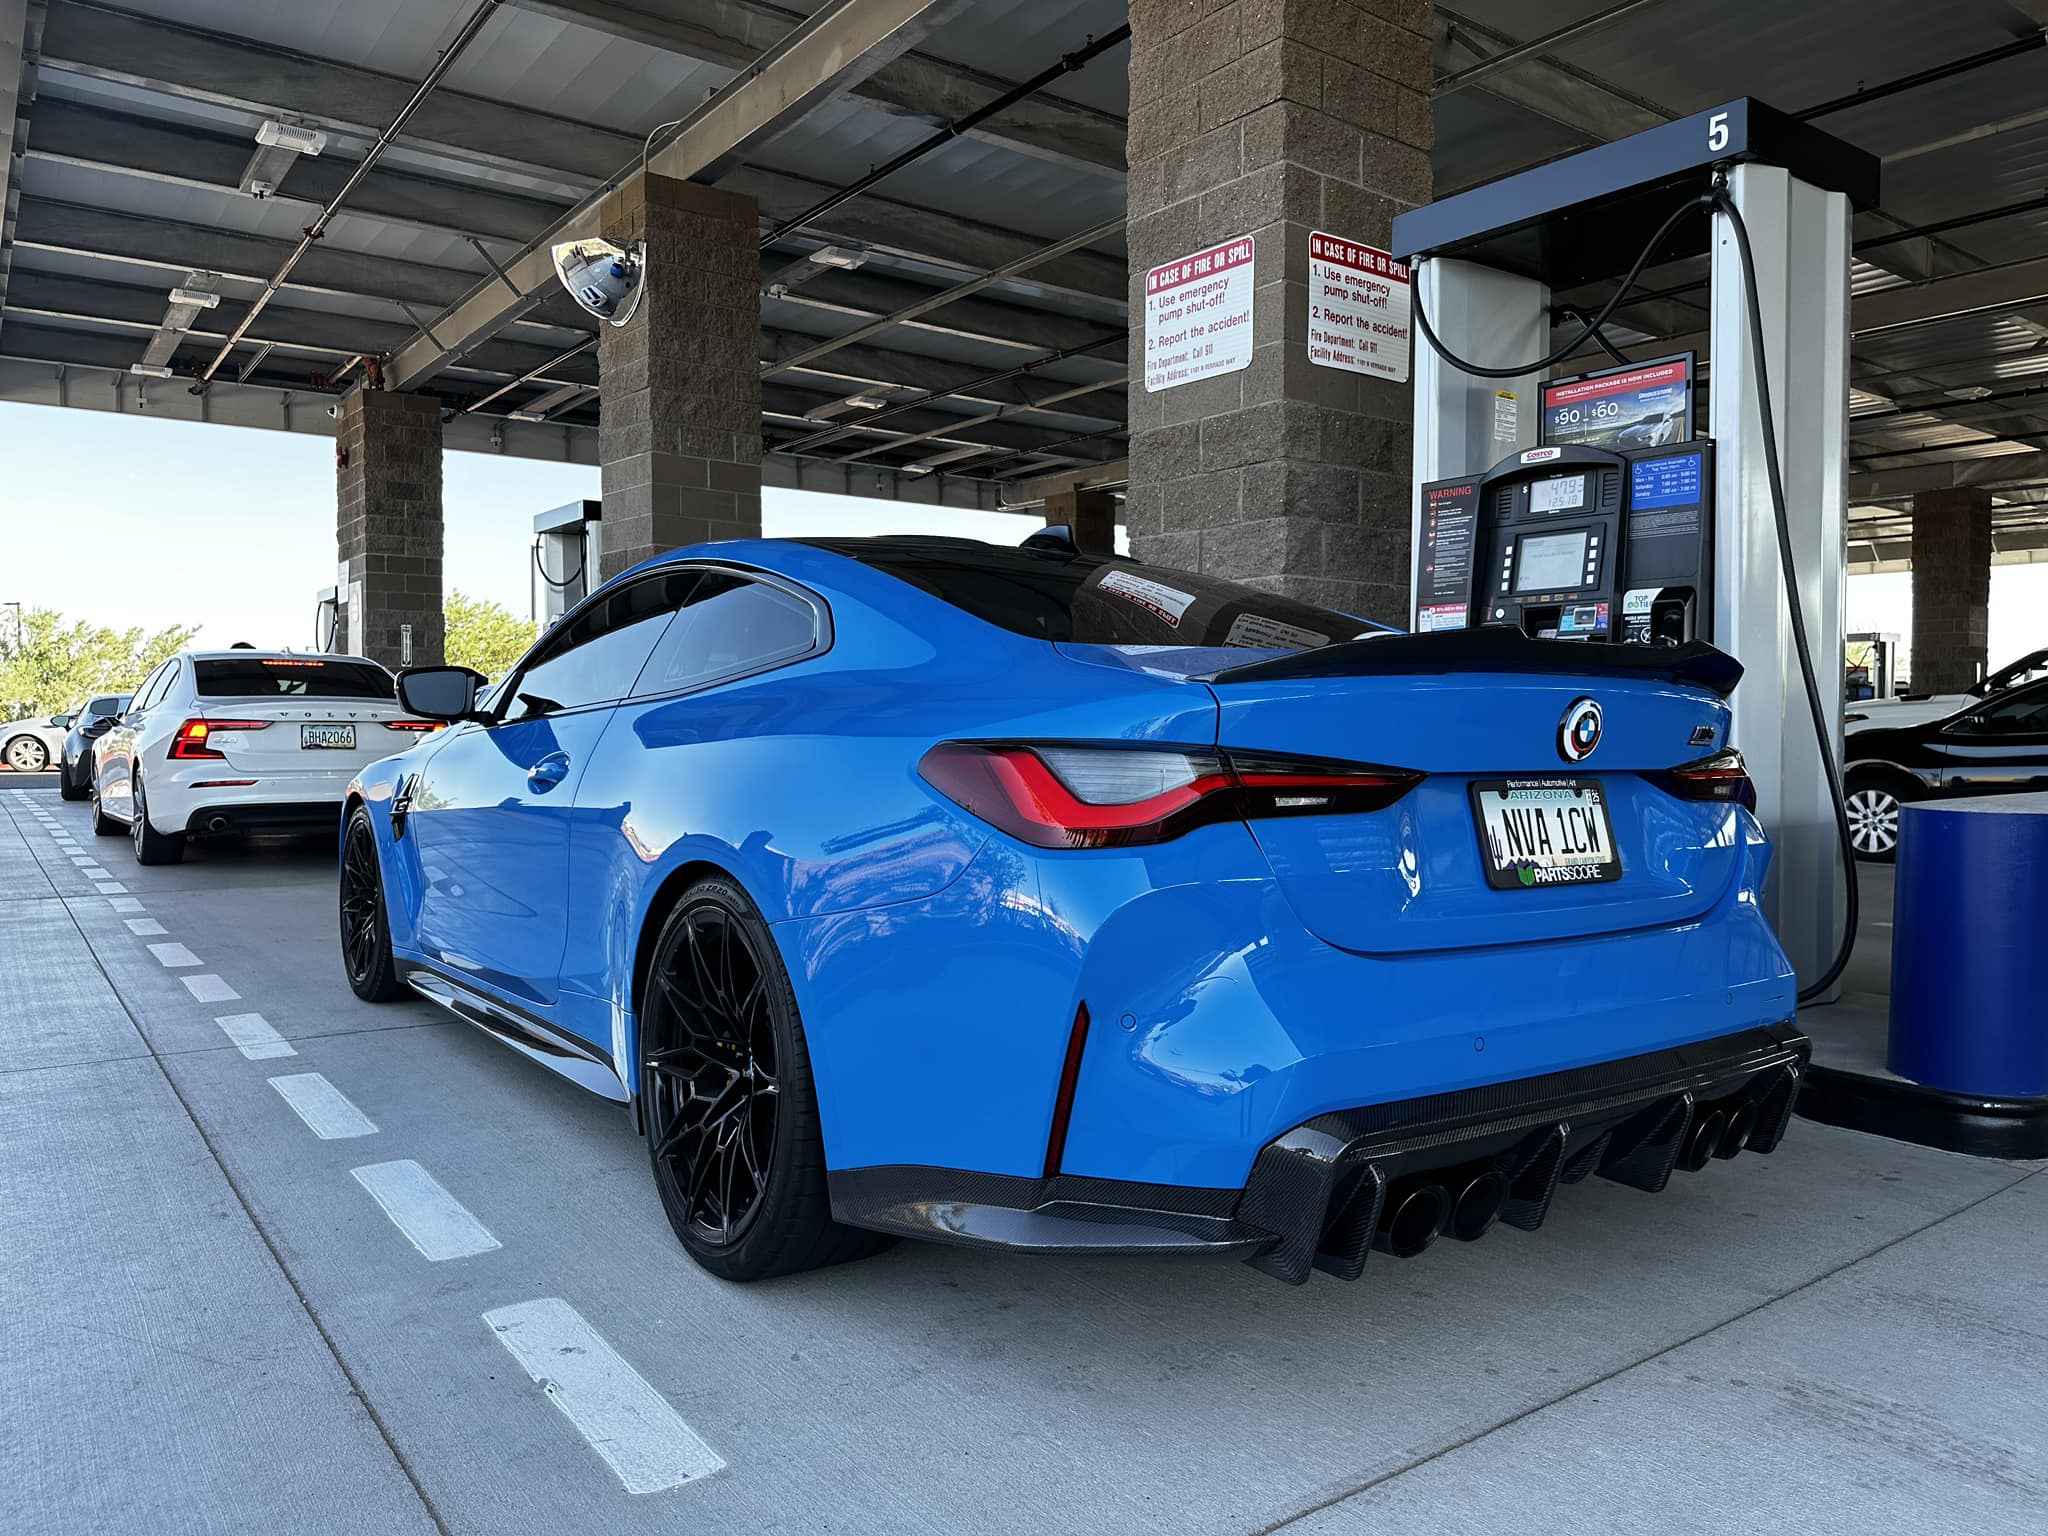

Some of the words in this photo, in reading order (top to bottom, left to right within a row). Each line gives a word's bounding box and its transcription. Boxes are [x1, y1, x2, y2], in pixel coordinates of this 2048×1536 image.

[1708, 112, 1728, 151] 5
[1149, 275, 1157, 290] IN
[1160, 267, 1179, 287] CASE
[1182, 263, 1191, 279] OF
[1194, 256, 1211, 275] FIRE
[1214, 252, 1225, 268] OR
[1228, 243, 1250, 263] SPILL
[1312, 238, 1321, 254] IN
[1324, 241, 1344, 260] CASE
[1347, 248, 1356, 263] OF
[1359, 251, 1374, 269] FIRE
[1377, 257, 1386, 272] OR
[1389, 260, 1407, 278] SPILL
[1313, 264, 1320, 277] 1.
[1324, 267, 1341, 282] Use
[1345, 274, 1390, 297] emergency
[1148, 301, 1156, 311] 1.
[1159, 295, 1175, 308] Use
[1179, 278, 1229, 301] emergency
[1324, 285, 1348, 301] pump
[1352, 291, 1387, 309] shut-off!
[1159, 308, 1182, 325] pump
[1186, 292, 1225, 314] shut-off!
[1148, 339, 1155, 350] 2.
[1159, 329, 1187, 348] Report
[1191, 326, 1204, 338] the
[1208, 311, 1249, 333] accident!
[1313, 306, 1320, 319] 2.
[1324, 308, 1353, 326] Report
[1356, 317, 1369, 330] the
[1372, 322, 1407, 339] accident!
[1311, 329, 1321, 341] Fire
[1324, 331, 1355, 348] Department:
[1359, 339, 1368, 351] Call
[1148, 361, 1157, 371] Fire
[1159, 352, 1188, 368] Department:
[1192, 346, 1203, 359] Call
[1205, 344, 1213, 356] 911
[1311, 345, 1331, 361] Facility
[1333, 350, 1355, 364] Address:
[1147, 374, 1165, 387] Facility
[1167, 368, 1189, 381] Address:
[1556, 384, 1594, 397] INSTALLATION
[1595, 380, 1620, 390] PACKAGE
[1628, 375, 1642, 383] NOW
[1643, 369, 1673, 380] INCLUDED
[1555, 410, 1580, 425] $90
[1592, 402, 1618, 418] $60
[1526, 450, 1553, 458] COSTCO
[1429, 486, 1472, 499] WARNING
[1523, 486, 1528, 494] $
[309, 731, 352, 744] BHA2066
[1507, 780, 1538, 788] Performance
[1541, 779, 1566, 787] Automotive
[1511, 790, 1573, 800] ARIZONA
[1502, 807, 1553, 857] NVA
[1556, 807, 1601, 854] 1CW
[1534, 864, 1602, 883] PARTSSCOPE
